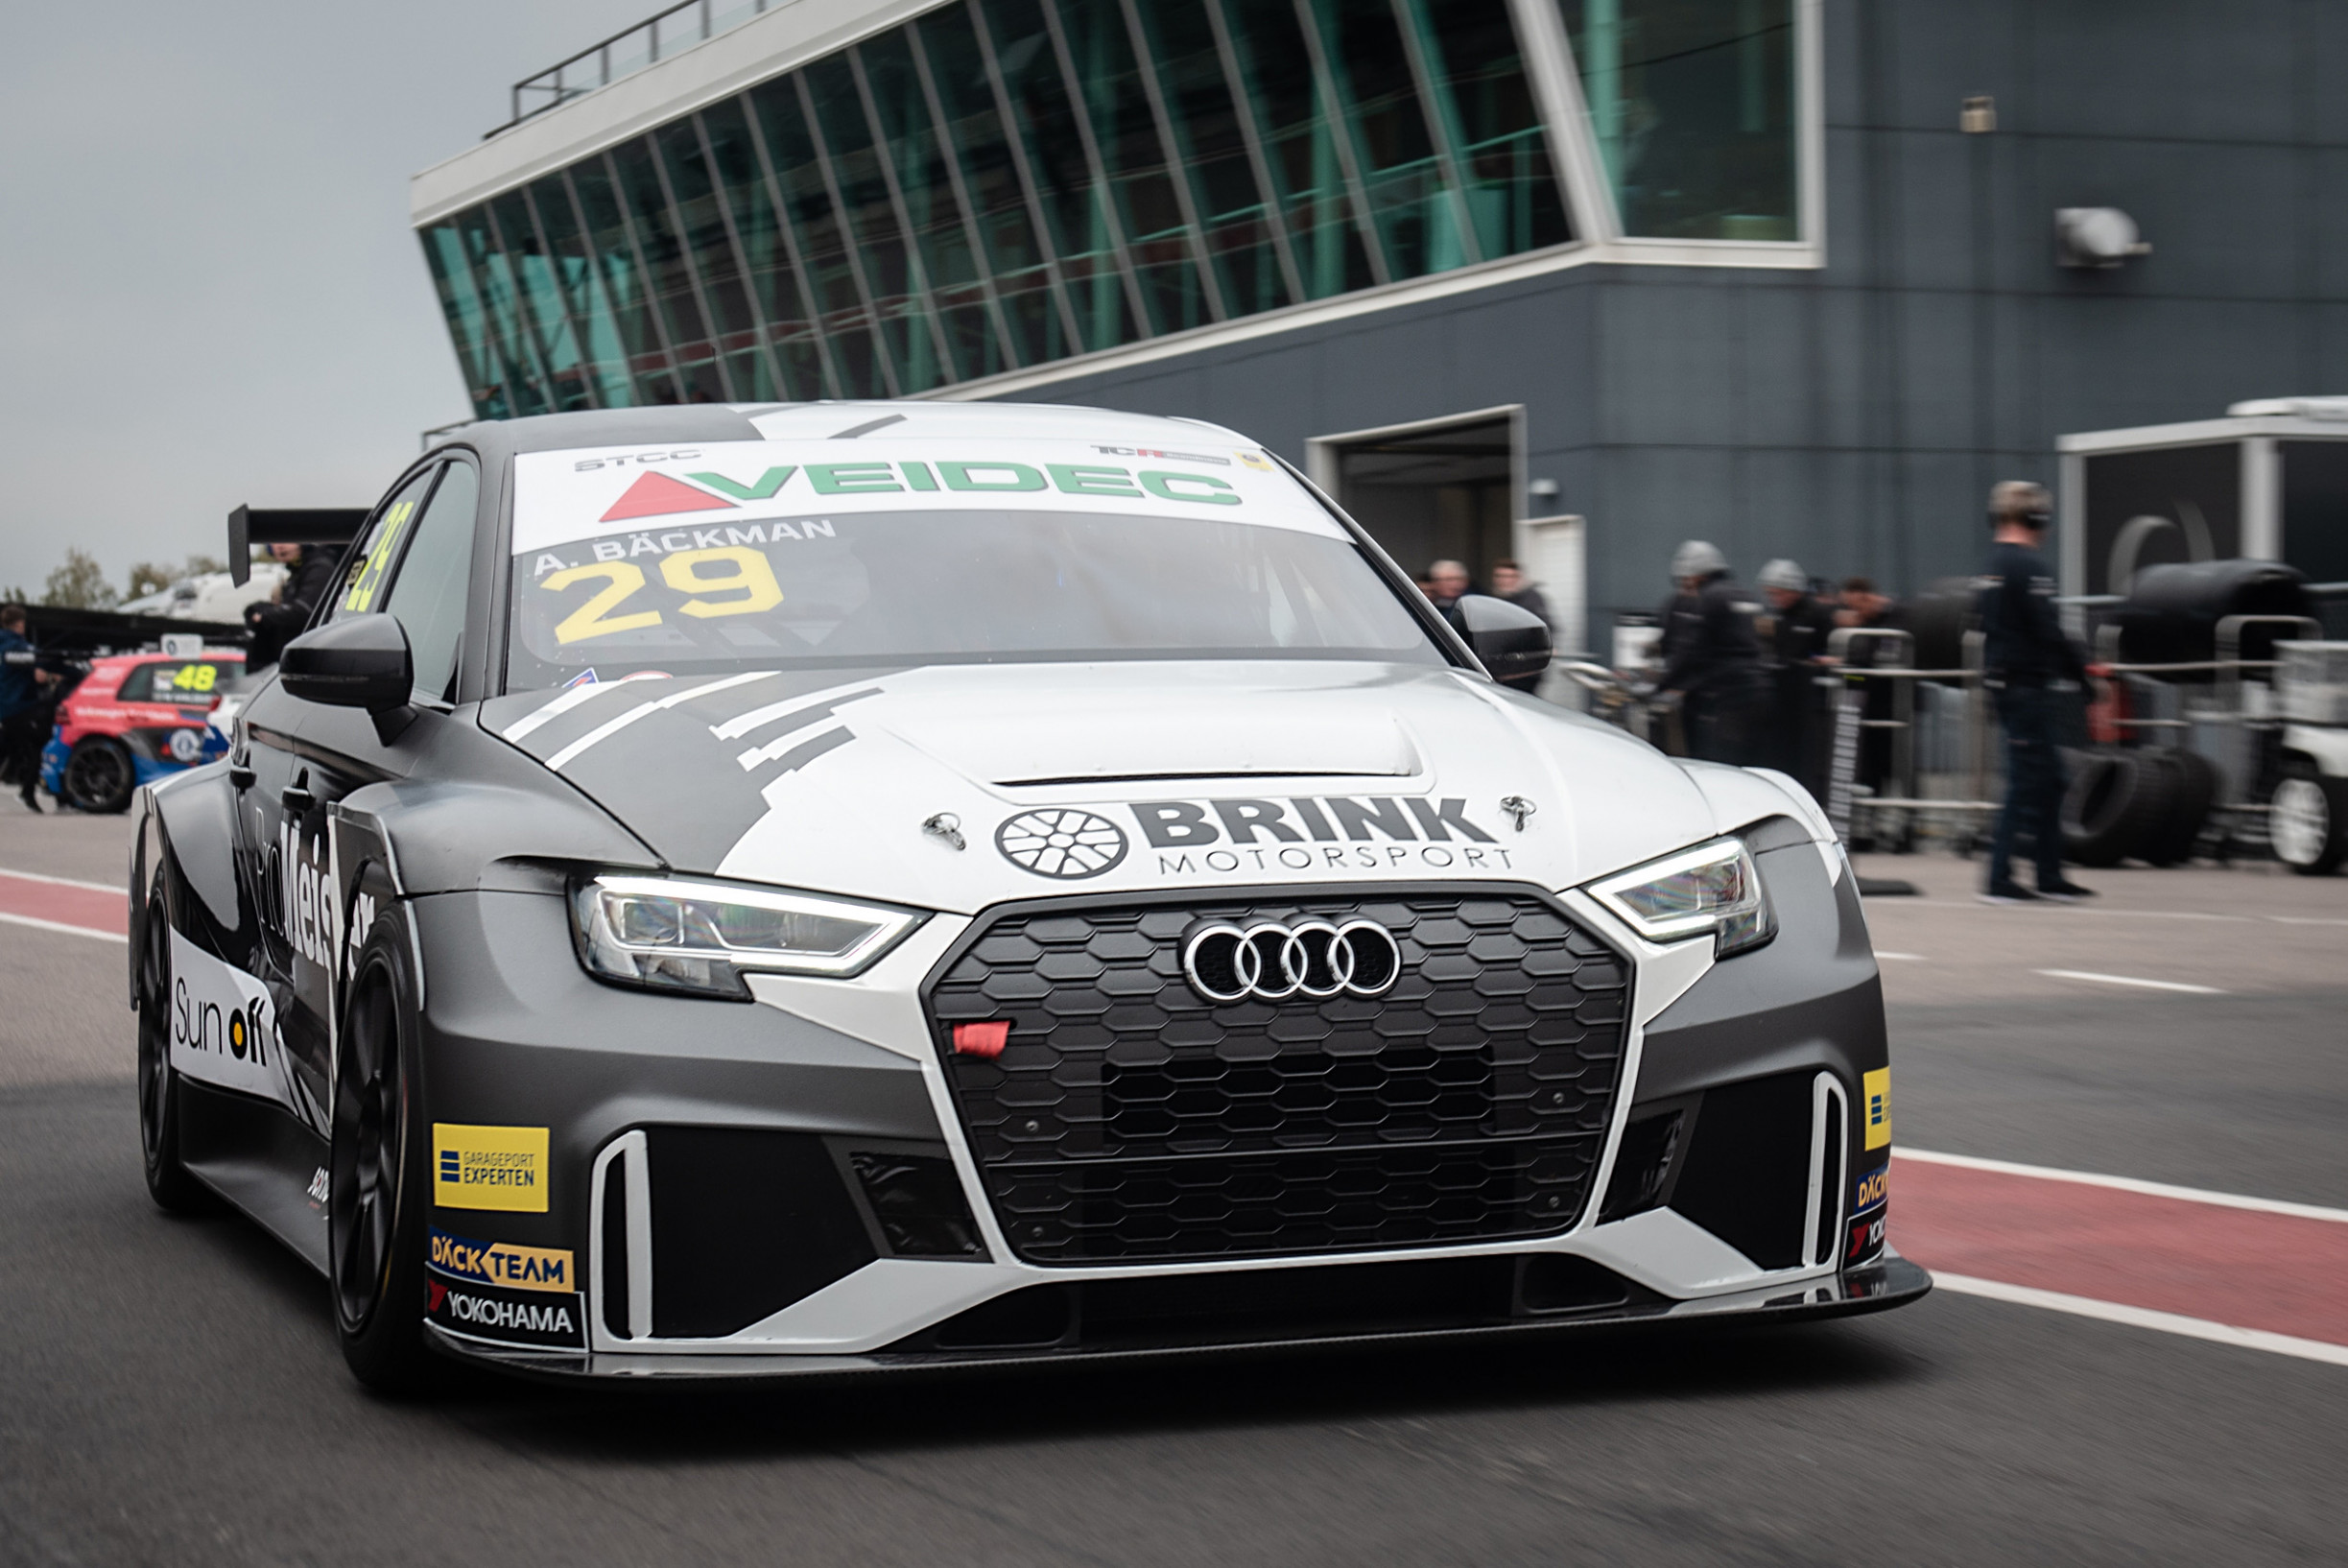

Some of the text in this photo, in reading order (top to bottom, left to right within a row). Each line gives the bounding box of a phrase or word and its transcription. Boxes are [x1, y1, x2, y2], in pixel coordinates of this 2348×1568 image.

[575, 448, 702, 472] STCC
[682, 461, 1243, 506] VEIDEC
[534, 519, 837, 577] A. BÄCKMAN
[539, 545, 784, 645] 29
[173, 665, 217, 691] 48
[1127, 796, 1500, 849] BRINK
[1158, 846, 1512, 875] MOTORSPORT
[176, 976, 268, 1067] Sun off
[463, 1151, 534, 1167] GARAGEPORT
[463, 1167, 534, 1187] EXPERTEN
[447, 1291, 574, 1333] YOKOHAMA
